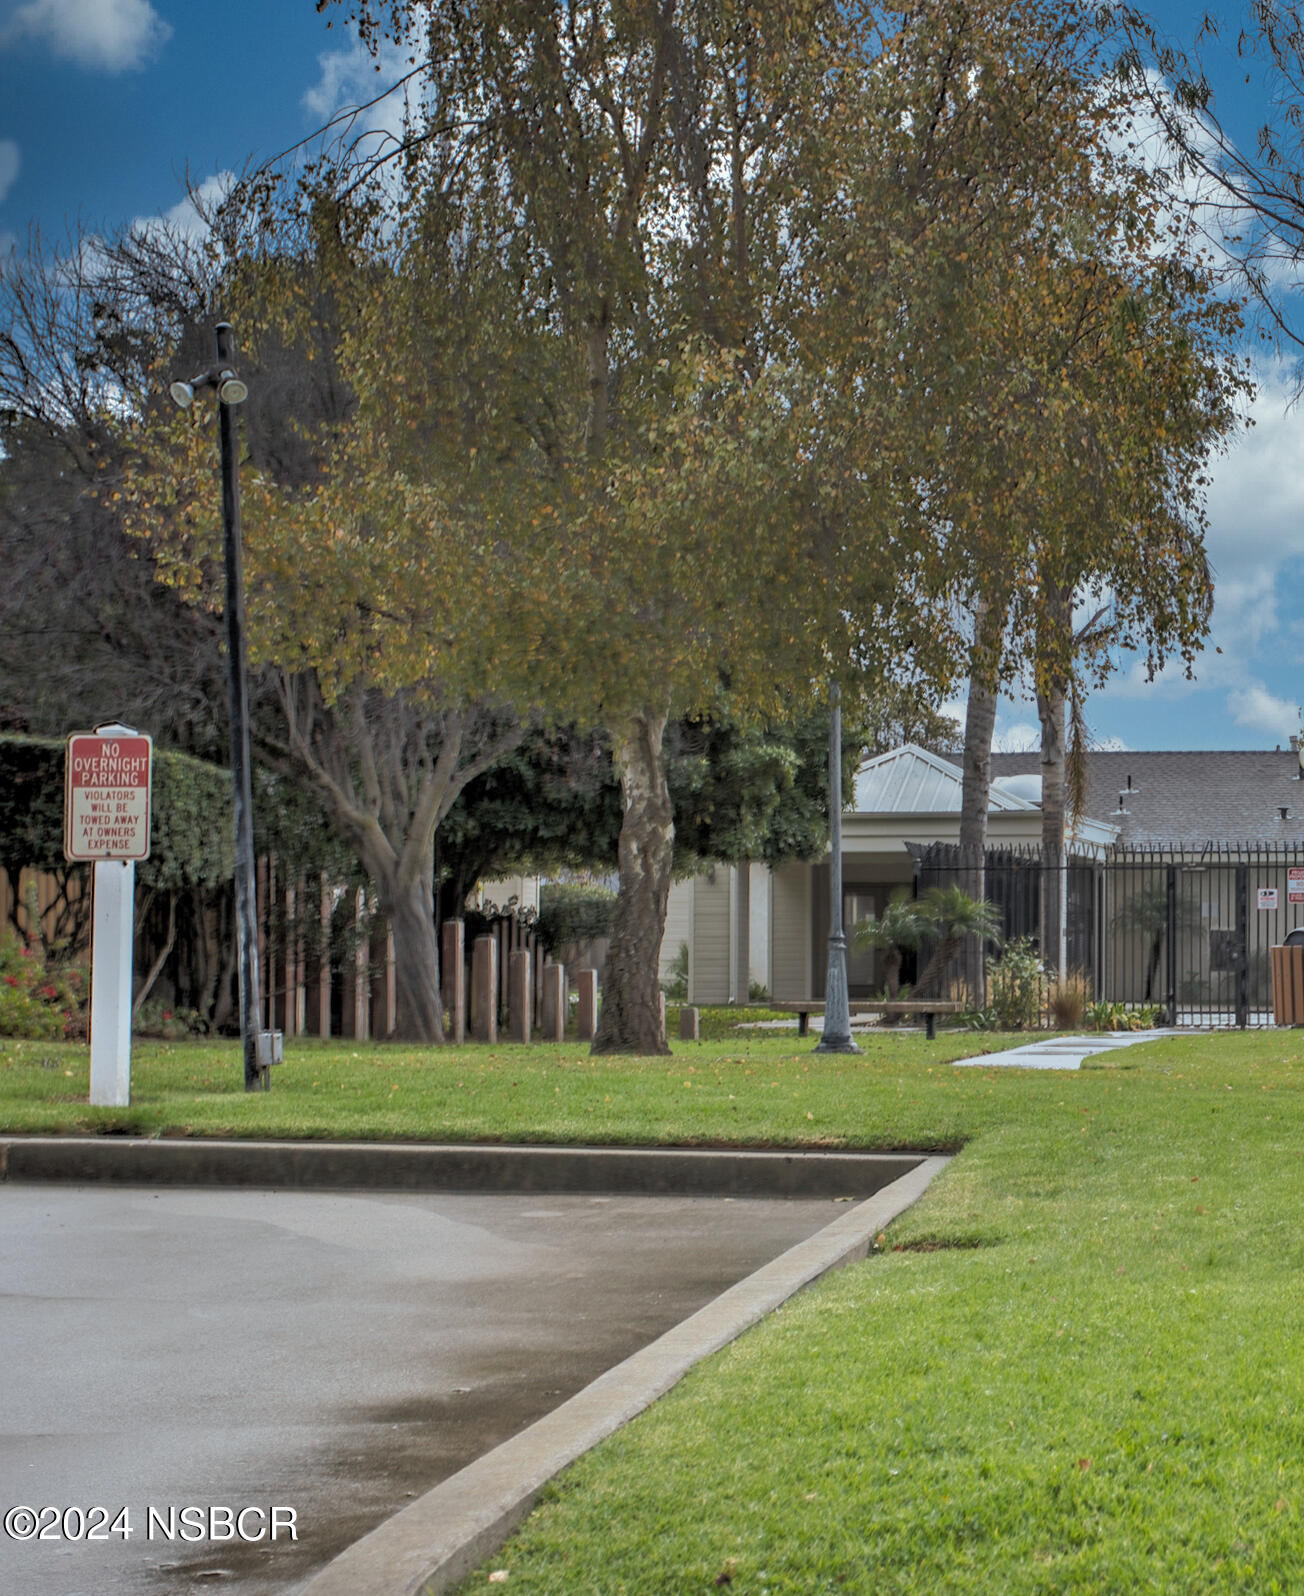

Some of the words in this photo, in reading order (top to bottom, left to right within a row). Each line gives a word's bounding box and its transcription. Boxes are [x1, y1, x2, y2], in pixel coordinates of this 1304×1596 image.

[102, 744, 120, 757] NO
[74, 758, 147, 771] OVERNIGHT
[81, 772, 138, 785] PARKING
[85, 791, 135, 800] VIOLATORS
[91, 803, 112, 812] WILL
[116, 803, 128, 812] BE
[80, 816, 110, 824] TOWED
[114, 816, 139, 824] AWAY
[82, 828, 94, 837] AT
[97, 828, 135, 837] OWNERS
[88, 840, 130, 849] EXPENSE
